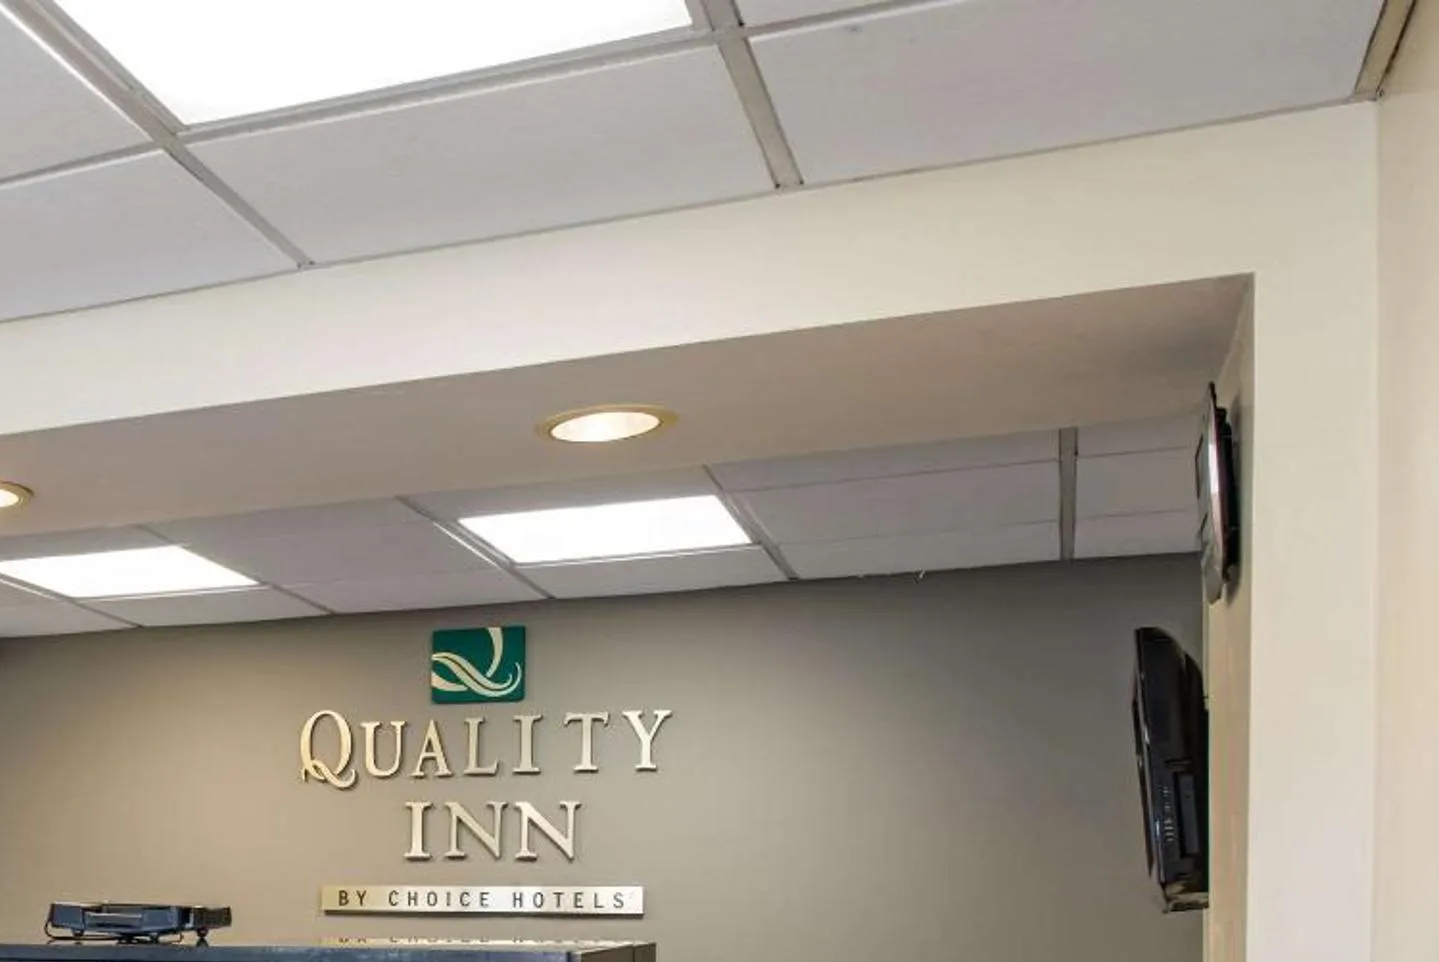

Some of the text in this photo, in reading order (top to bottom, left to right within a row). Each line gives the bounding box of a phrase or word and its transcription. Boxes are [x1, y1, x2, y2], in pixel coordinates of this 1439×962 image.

[300, 709, 673, 789] QUALITY
[403, 800, 581, 863] INN
[338, 890, 627, 910] BY CHOICE HOTELS
